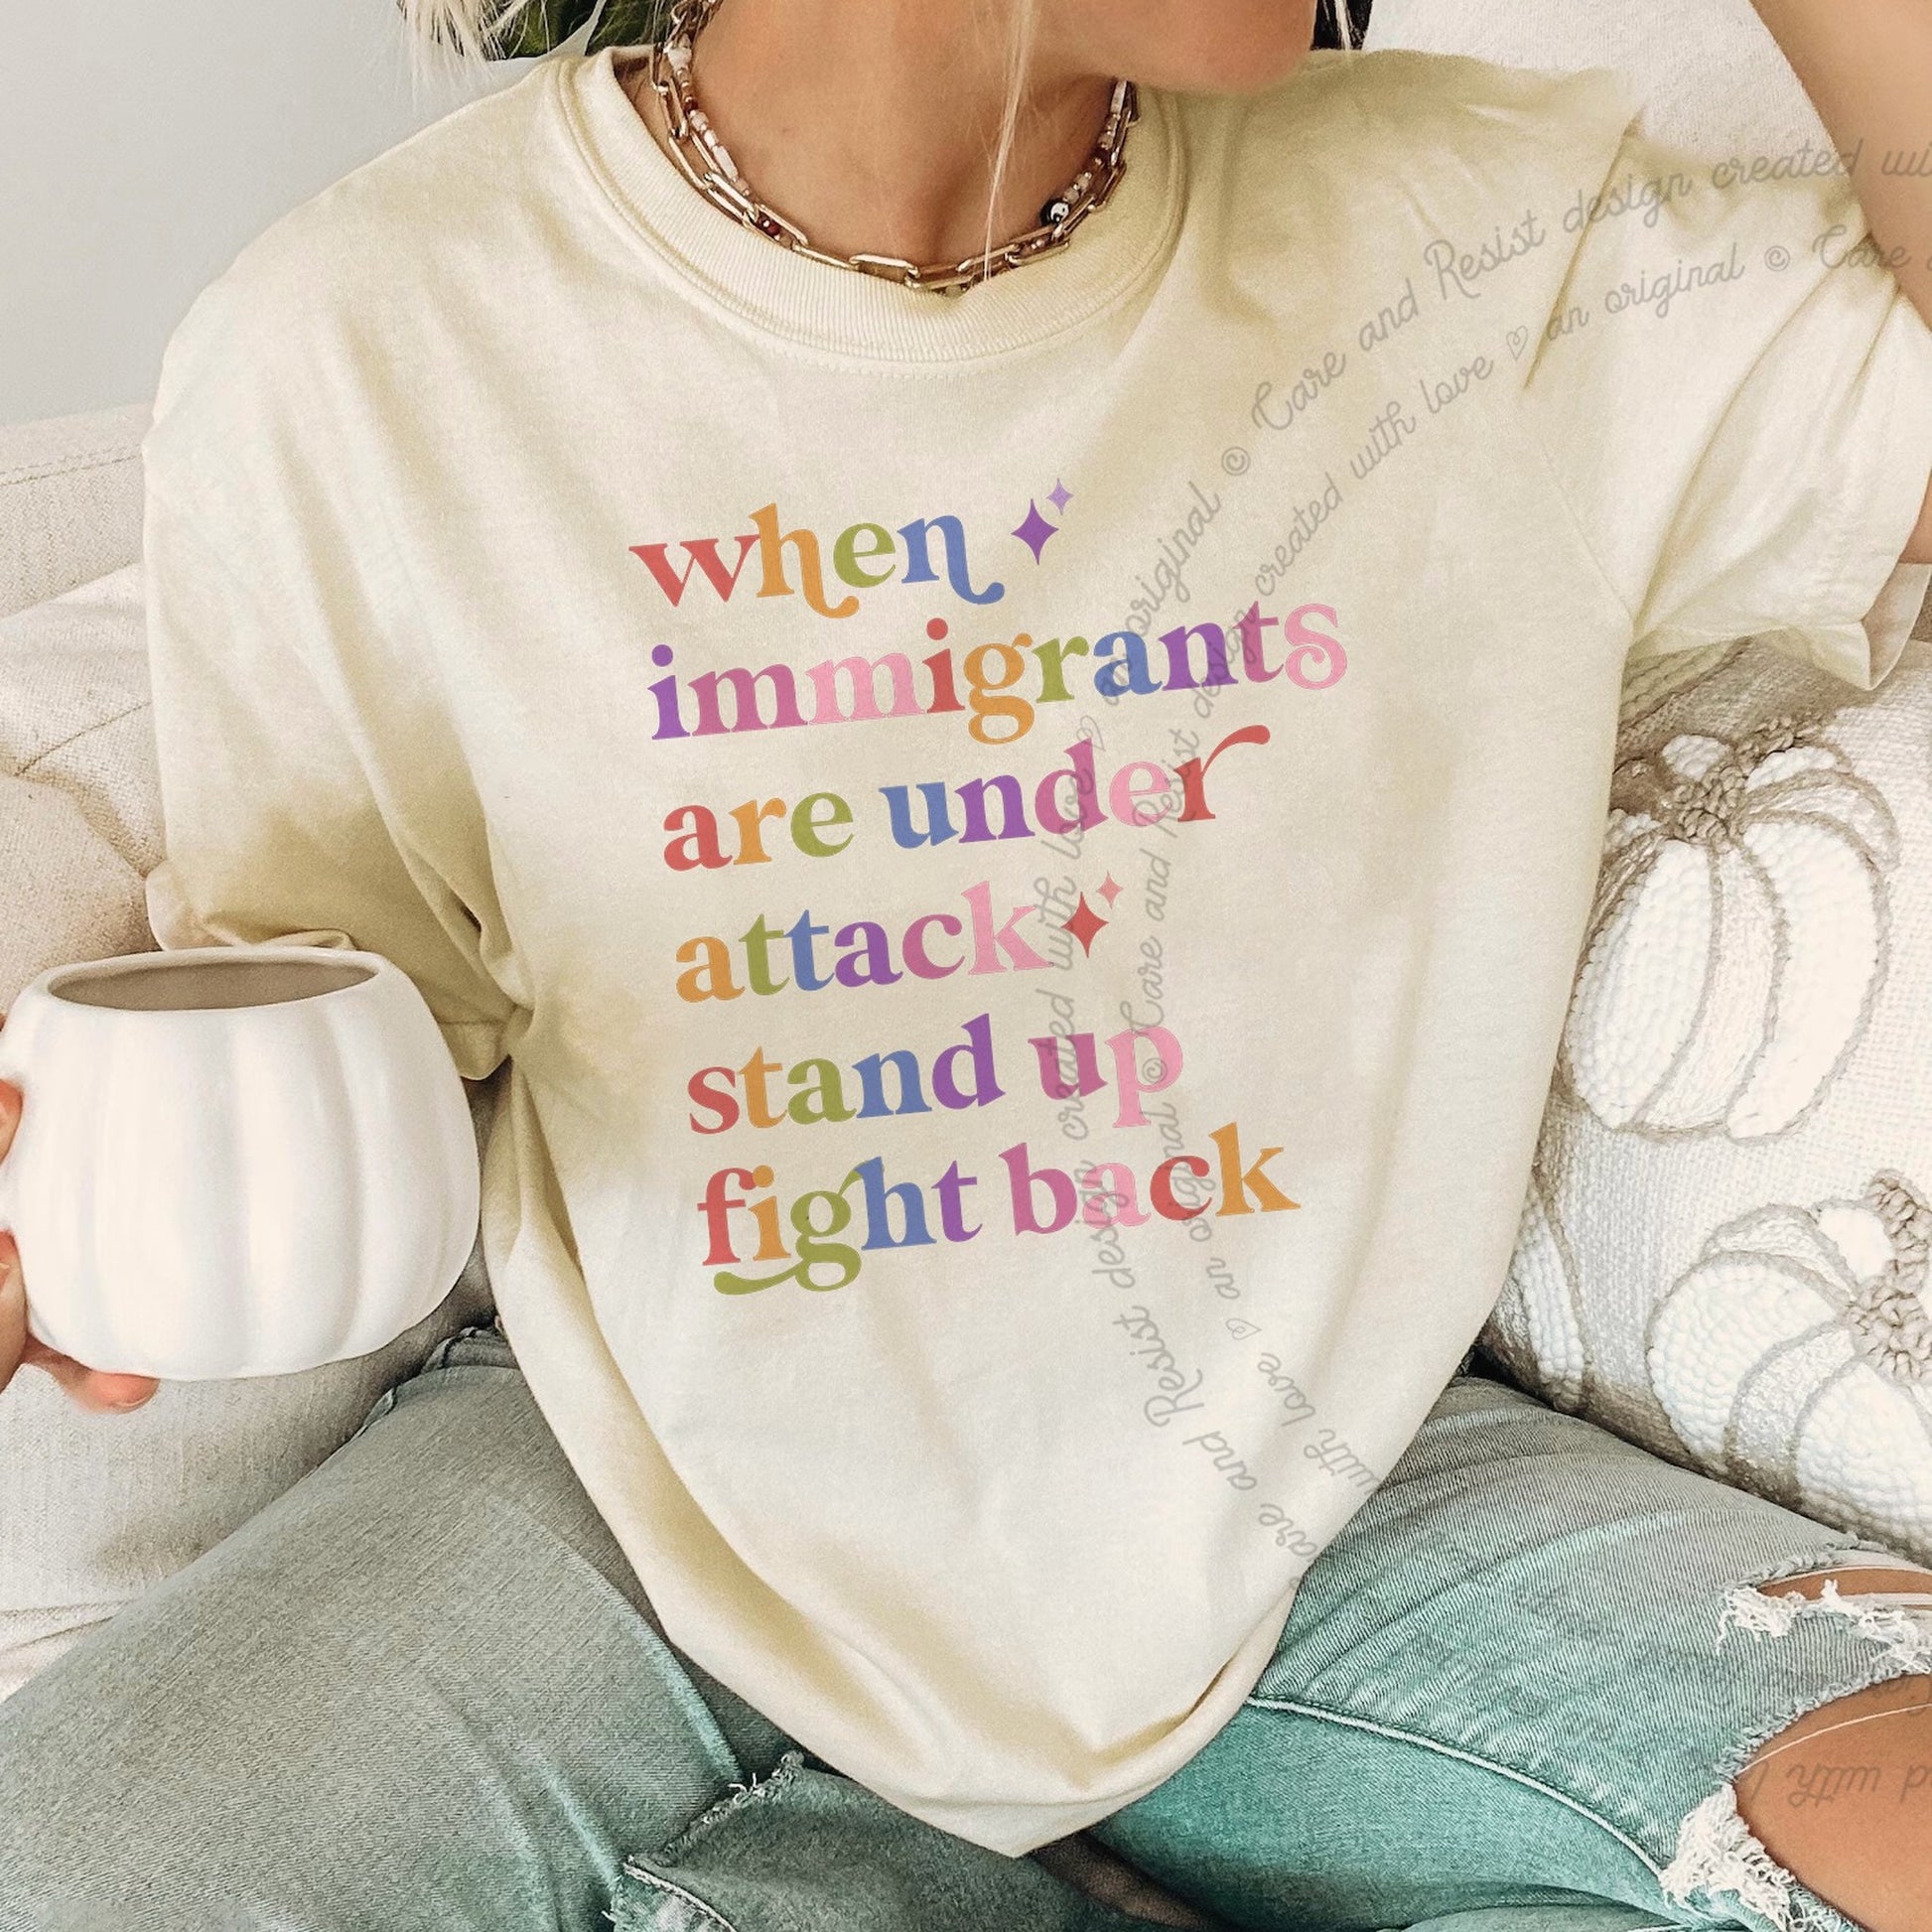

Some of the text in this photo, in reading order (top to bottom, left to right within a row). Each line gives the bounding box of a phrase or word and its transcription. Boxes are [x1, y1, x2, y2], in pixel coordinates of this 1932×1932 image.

[628, 502, 1005, 619] when
[647, 600, 1348, 745] immigrants
[662, 725, 1271, 872] are under
[675, 881, 1054, 1003] attack
[687, 1013, 1183, 1134] stand up
[698, 1122, 1302, 1295] fight back
